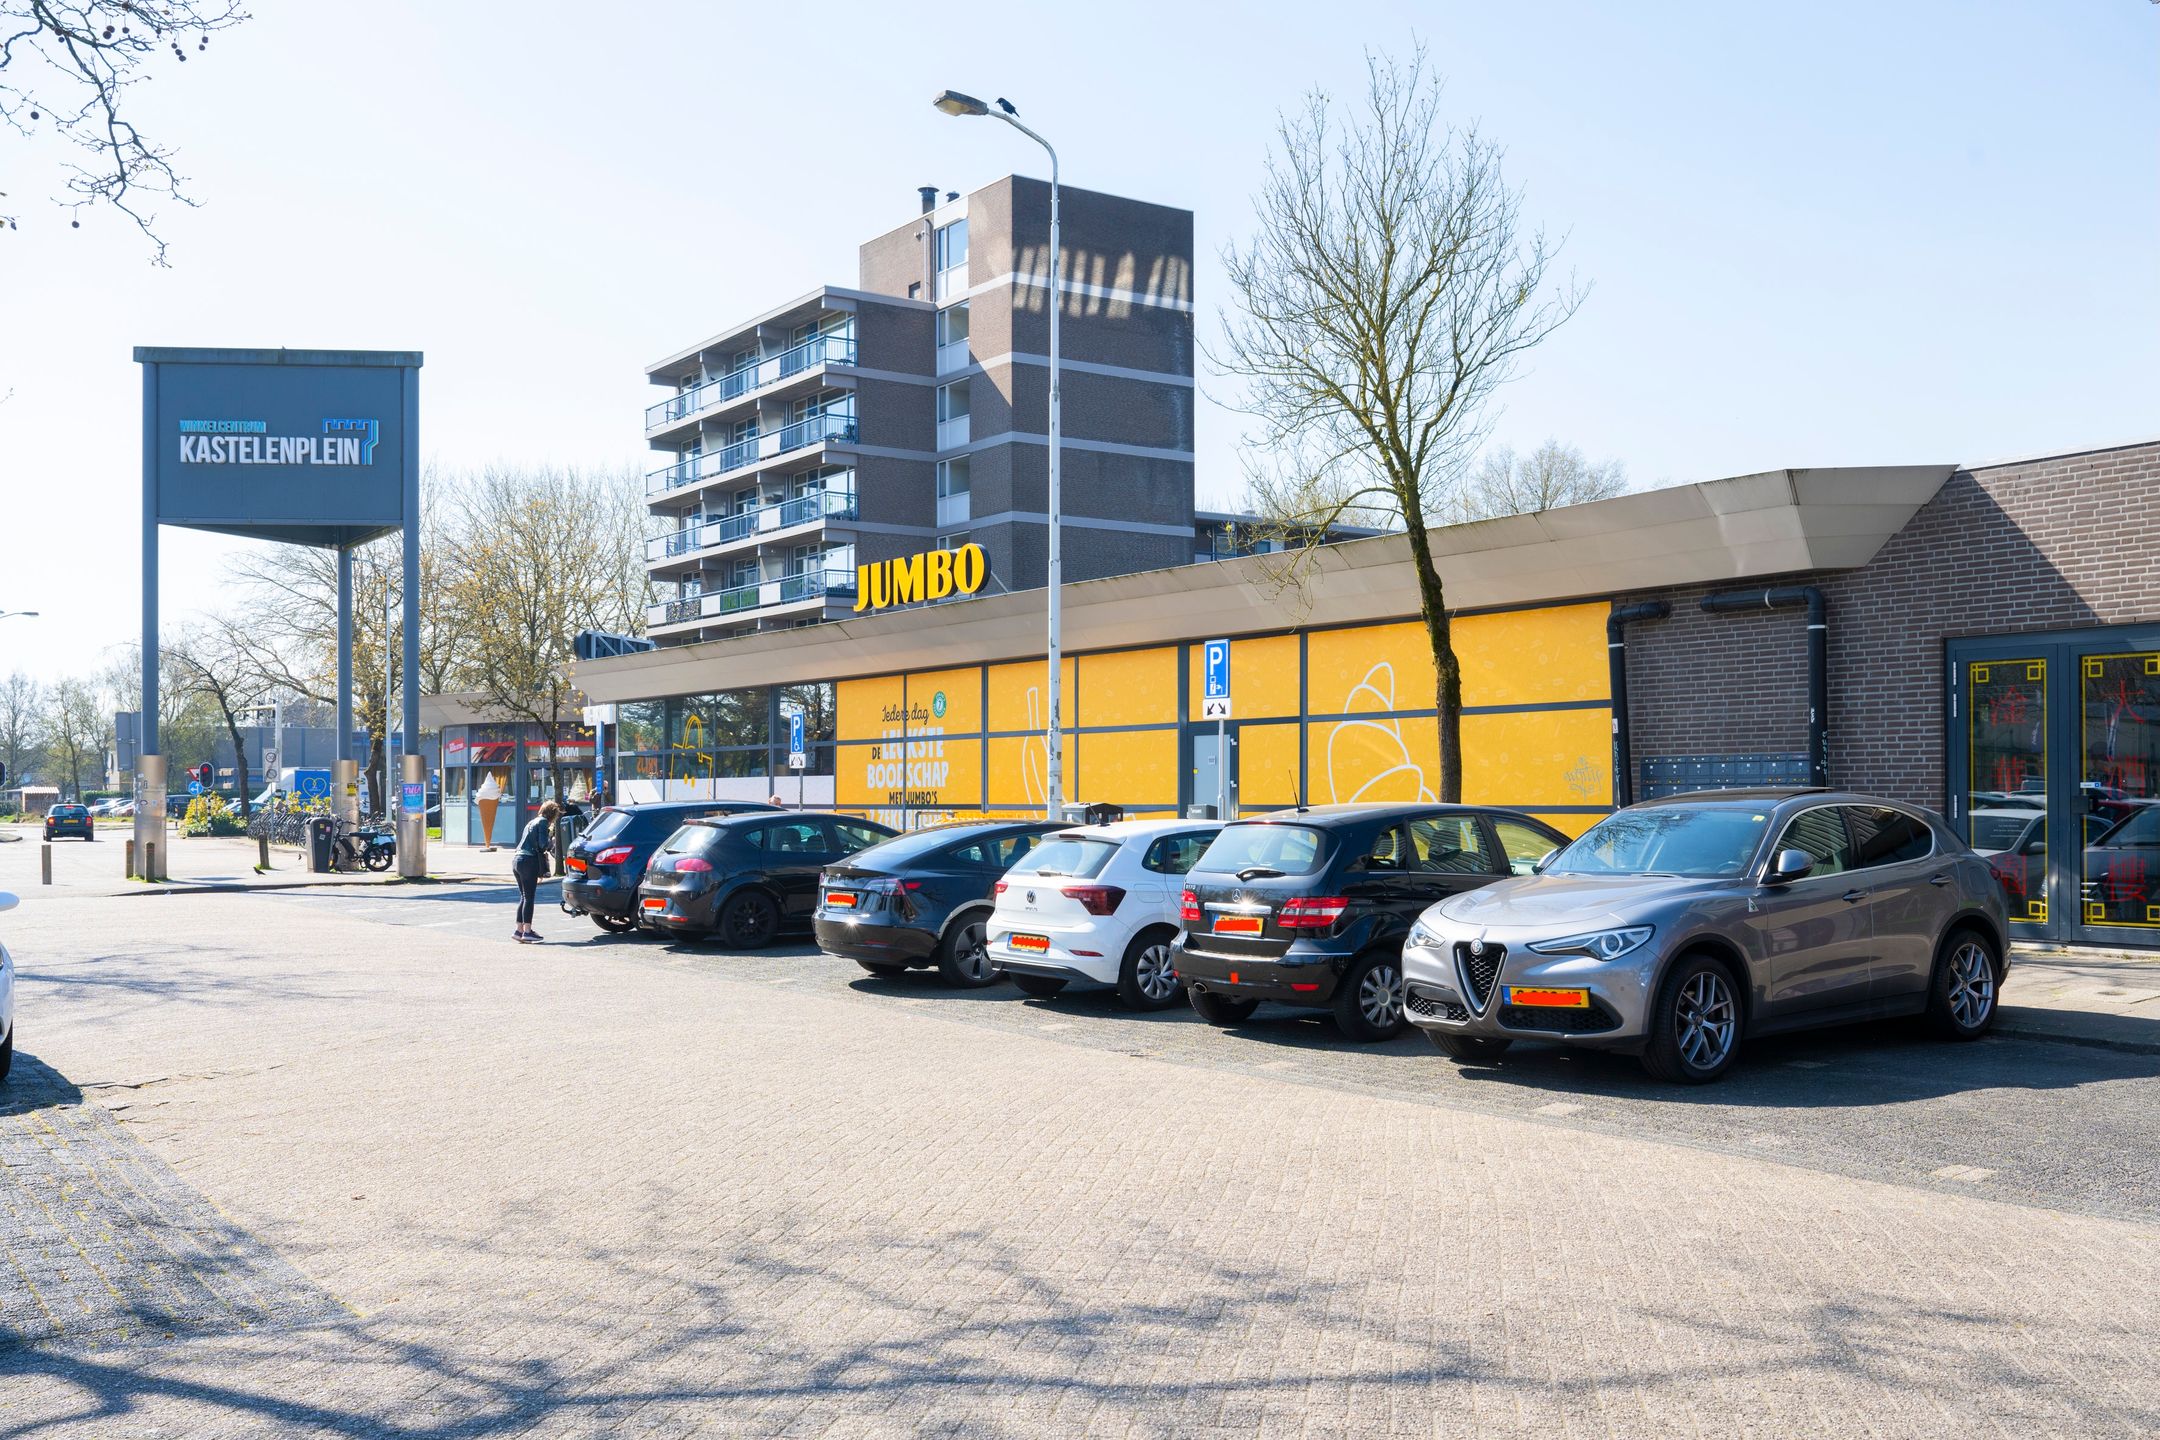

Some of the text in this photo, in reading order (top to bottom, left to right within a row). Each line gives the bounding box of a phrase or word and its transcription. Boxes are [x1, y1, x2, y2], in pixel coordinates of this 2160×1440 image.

[180, 420, 266, 433] WINKELCENTRUM
[180, 436, 359, 464] KASTELENPLEIN
[853, 543, 986, 612] JUMBO
[1210, 647, 1223, 675] P
[911, 702, 929, 725] dag
[540, 746, 579, 758] WLKOM
[872, 747, 881, 760] DE
[867, 761, 949, 789] BOODSCHAP
[889, 791, 937, 805] MET JUMBO'S
